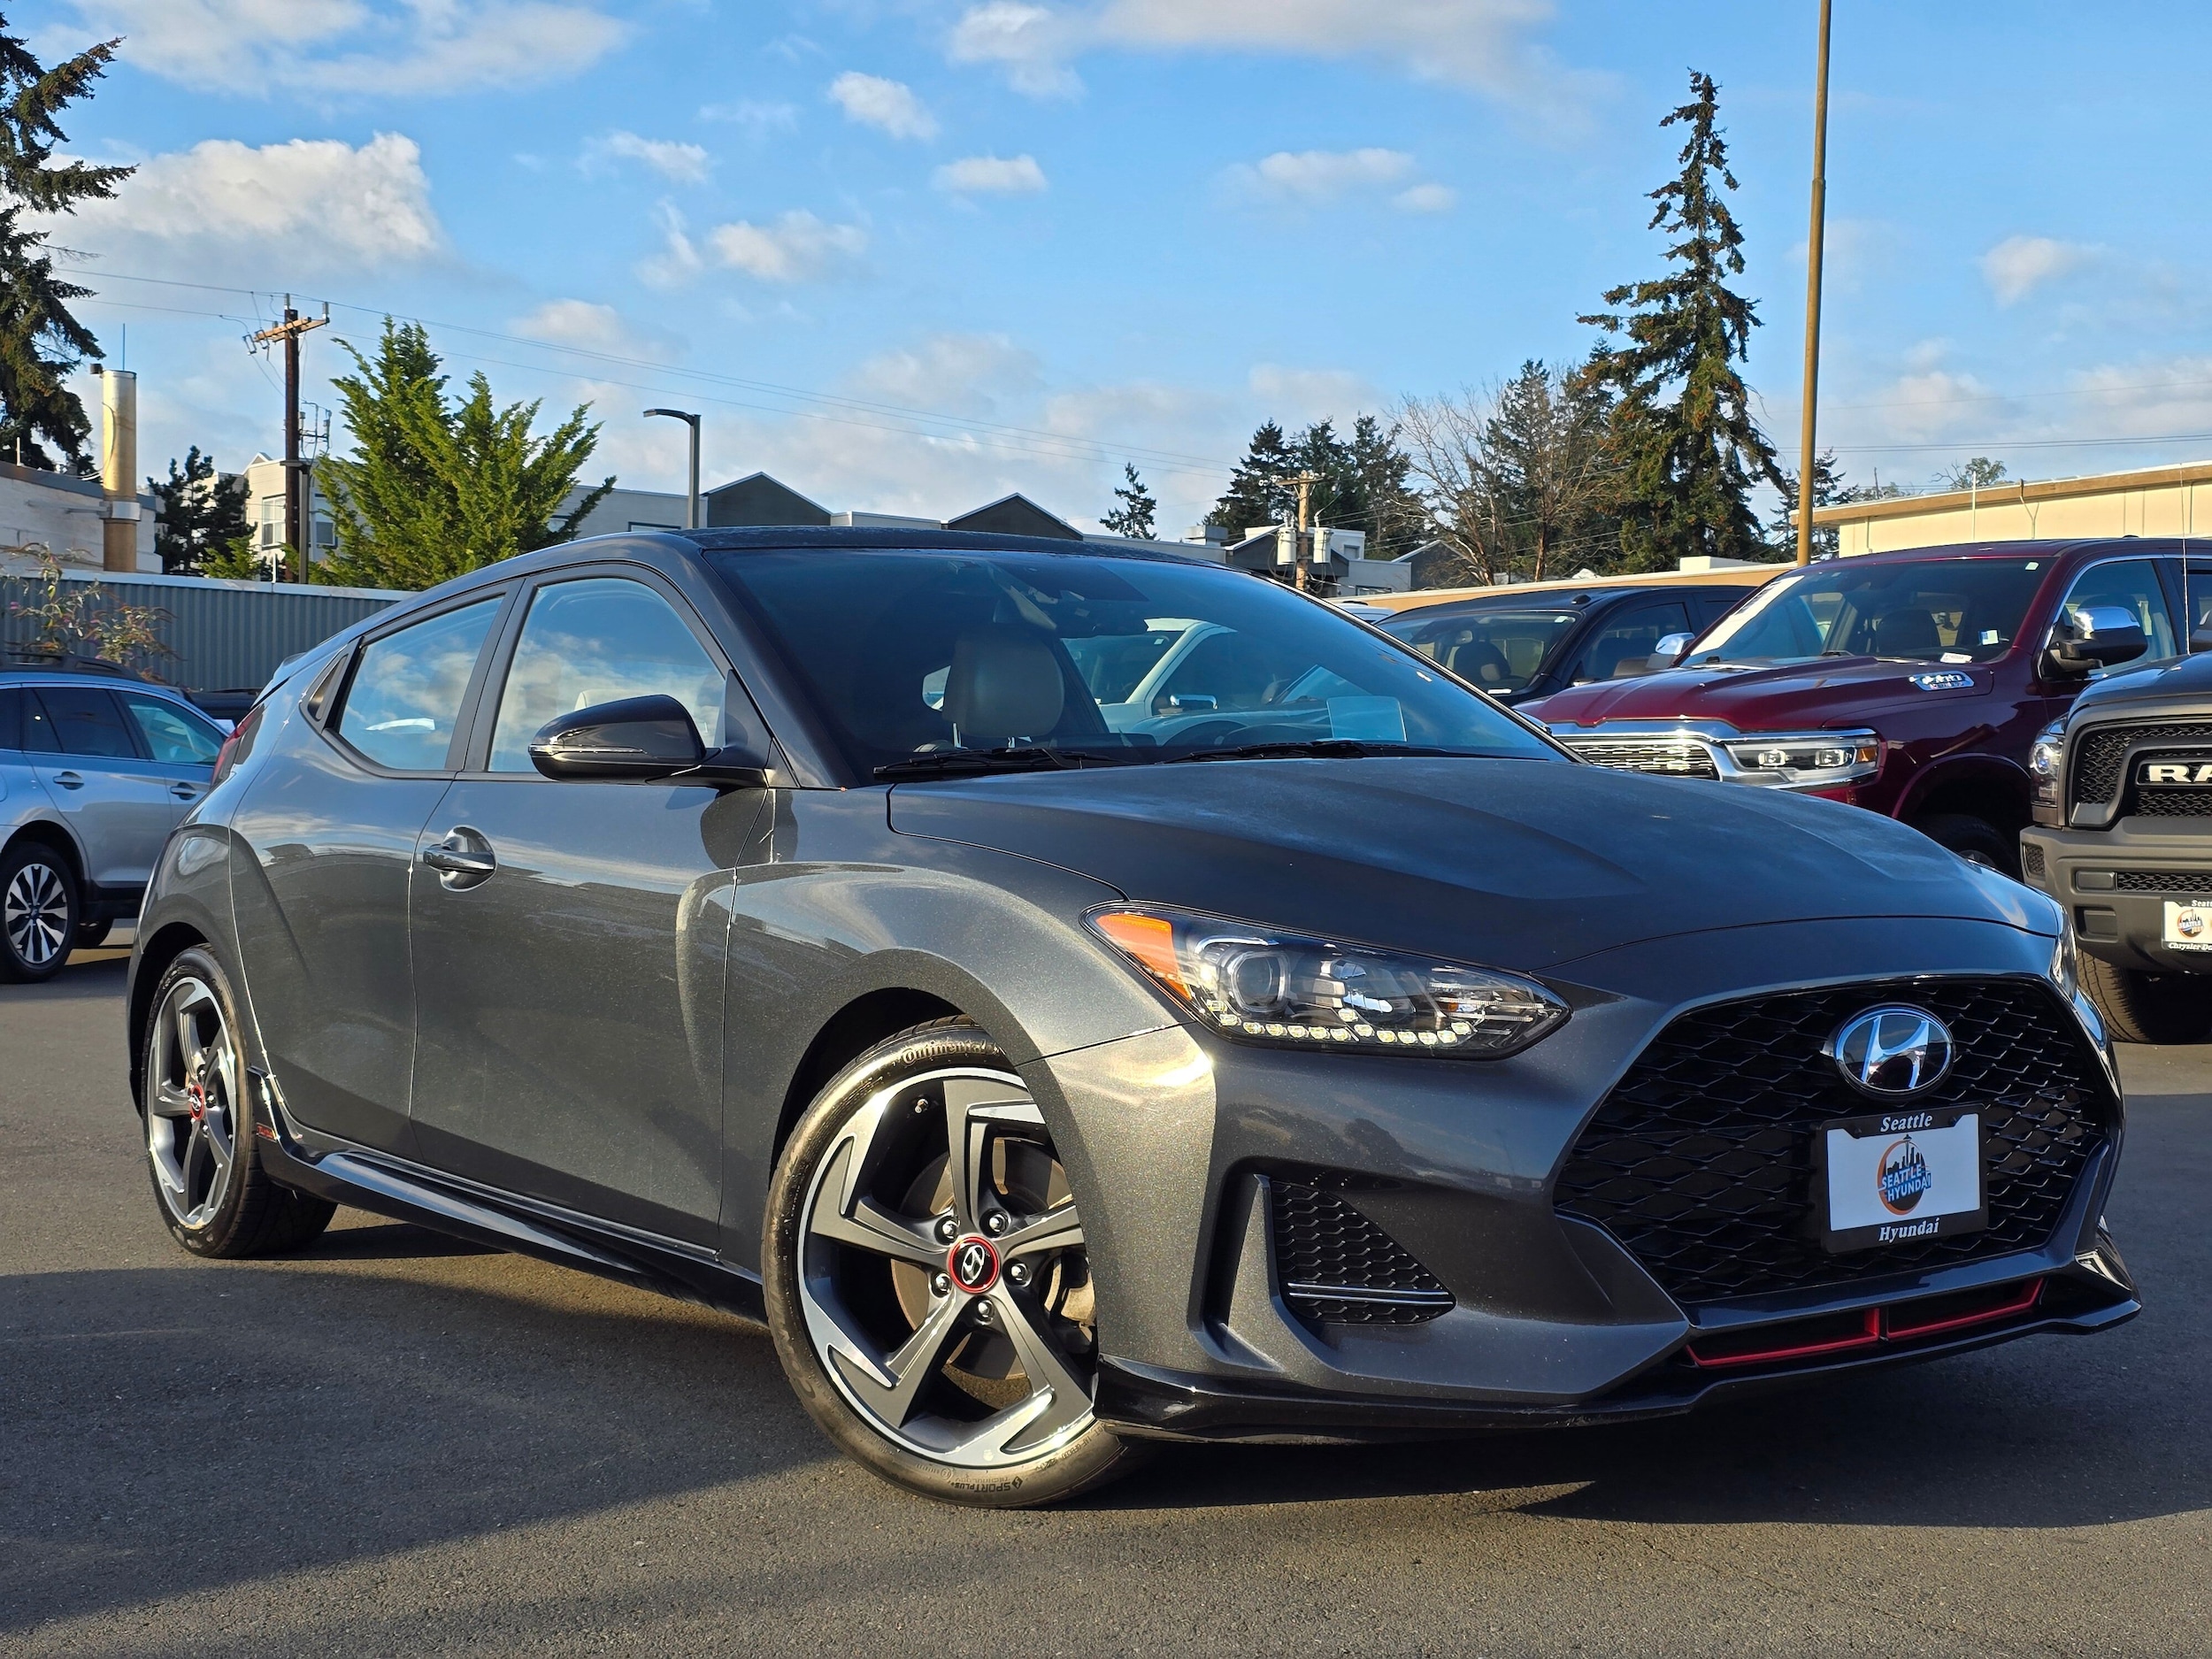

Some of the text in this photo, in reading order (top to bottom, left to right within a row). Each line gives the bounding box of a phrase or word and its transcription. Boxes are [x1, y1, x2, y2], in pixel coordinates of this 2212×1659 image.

[2168, 941, 2201, 951] Chrysler
[1880, 1112, 1933, 1133] Seattle
[1881, 1164, 1922, 1189] SEATTLE
[1887, 1173, 1931, 1202] HYUNDAI
[1878, 1217, 1940, 1244] Hyundai
